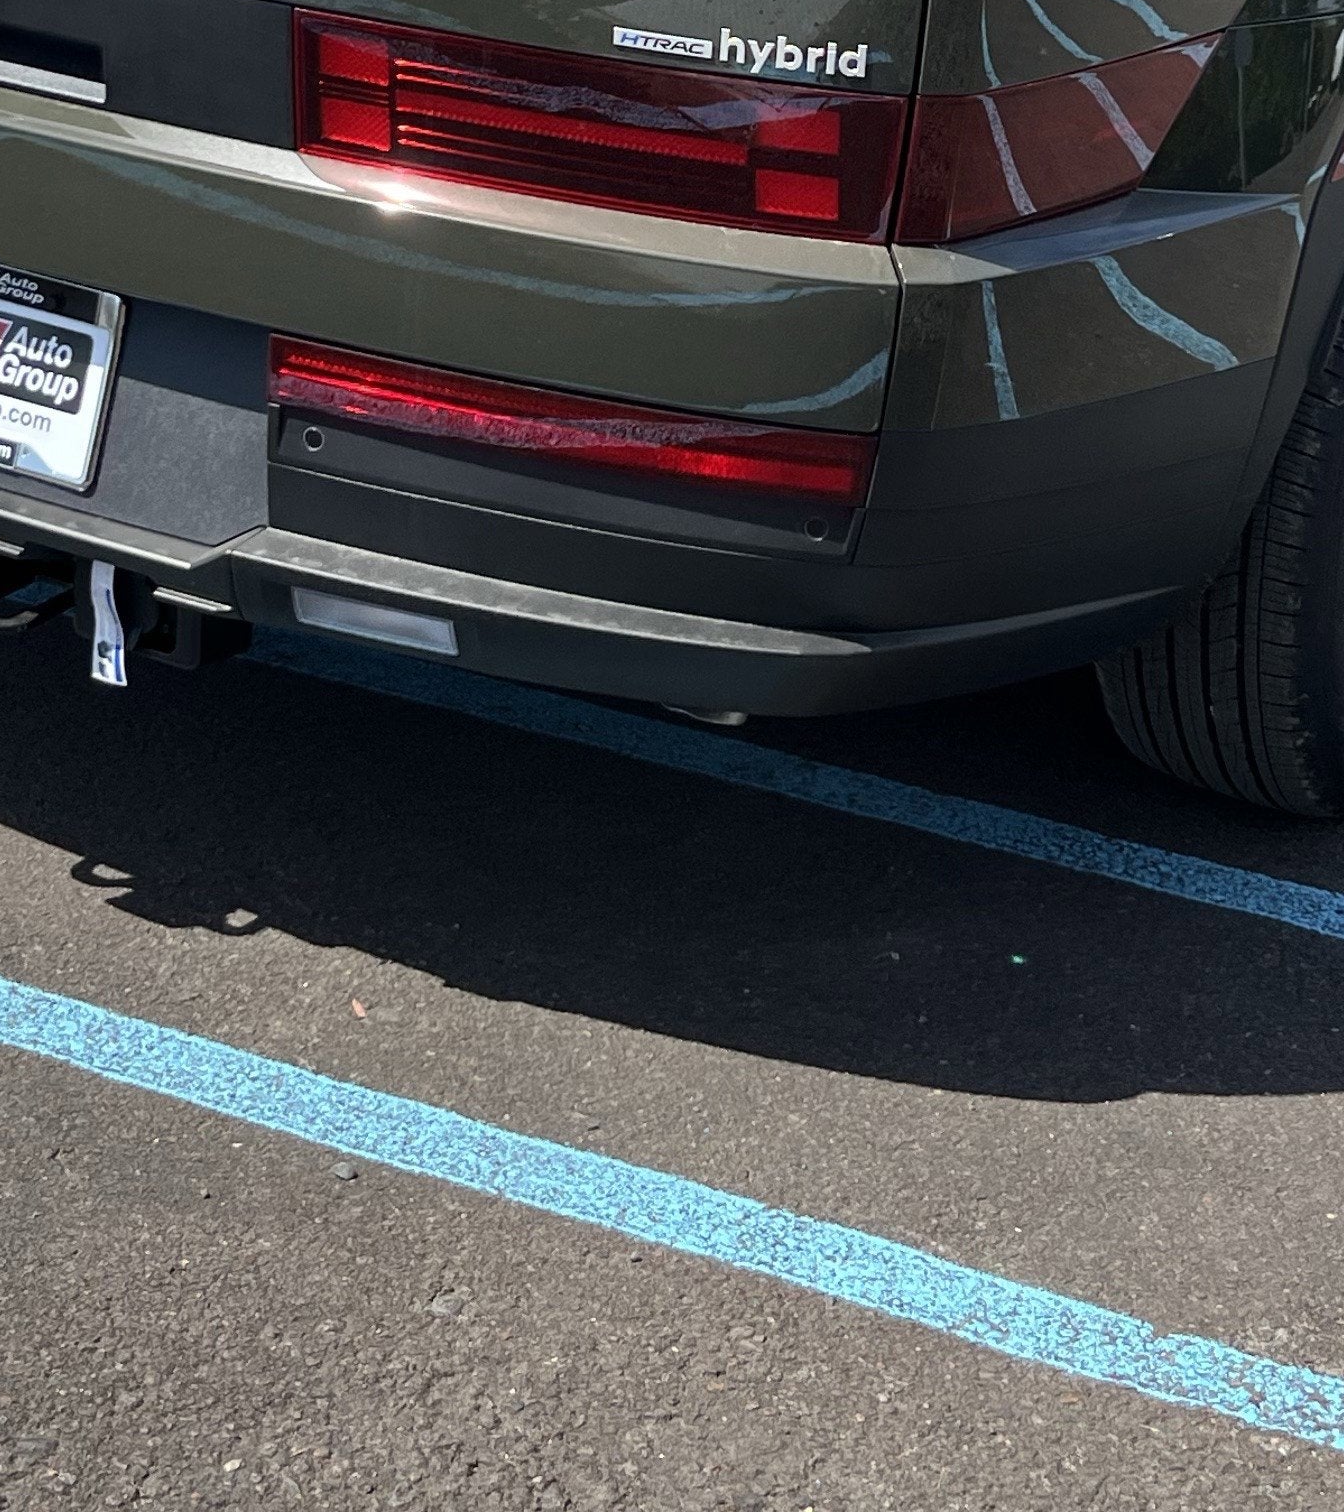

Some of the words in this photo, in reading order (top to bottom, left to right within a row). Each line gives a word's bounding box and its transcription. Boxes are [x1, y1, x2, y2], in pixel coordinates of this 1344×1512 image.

[619, 31, 706, 56] HTRAC
[718, 27, 870, 79] hybrid
[4, 325, 74, 368] Auto
